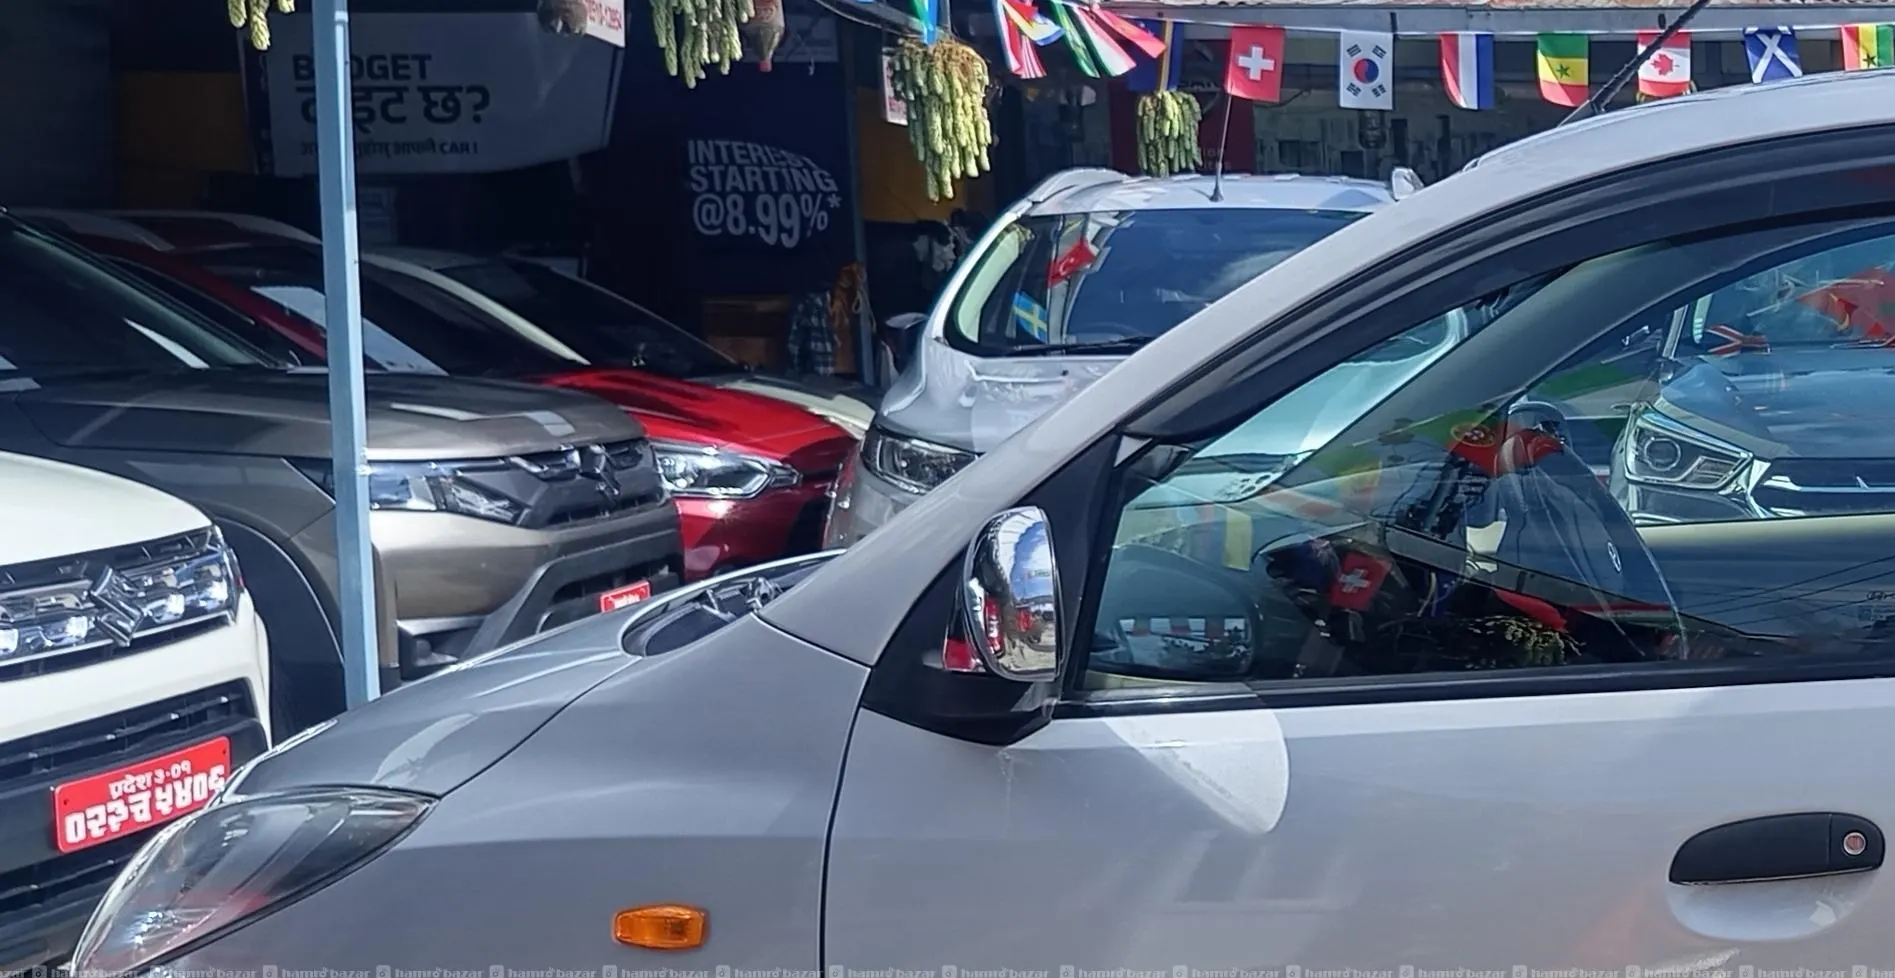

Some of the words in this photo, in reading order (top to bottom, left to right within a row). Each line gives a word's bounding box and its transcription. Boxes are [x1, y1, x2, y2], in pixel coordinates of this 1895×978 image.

[293, 53, 432, 81] BDGET
[687, 139, 820, 169] INTEREST
[690, 165, 839, 193] STARTING
